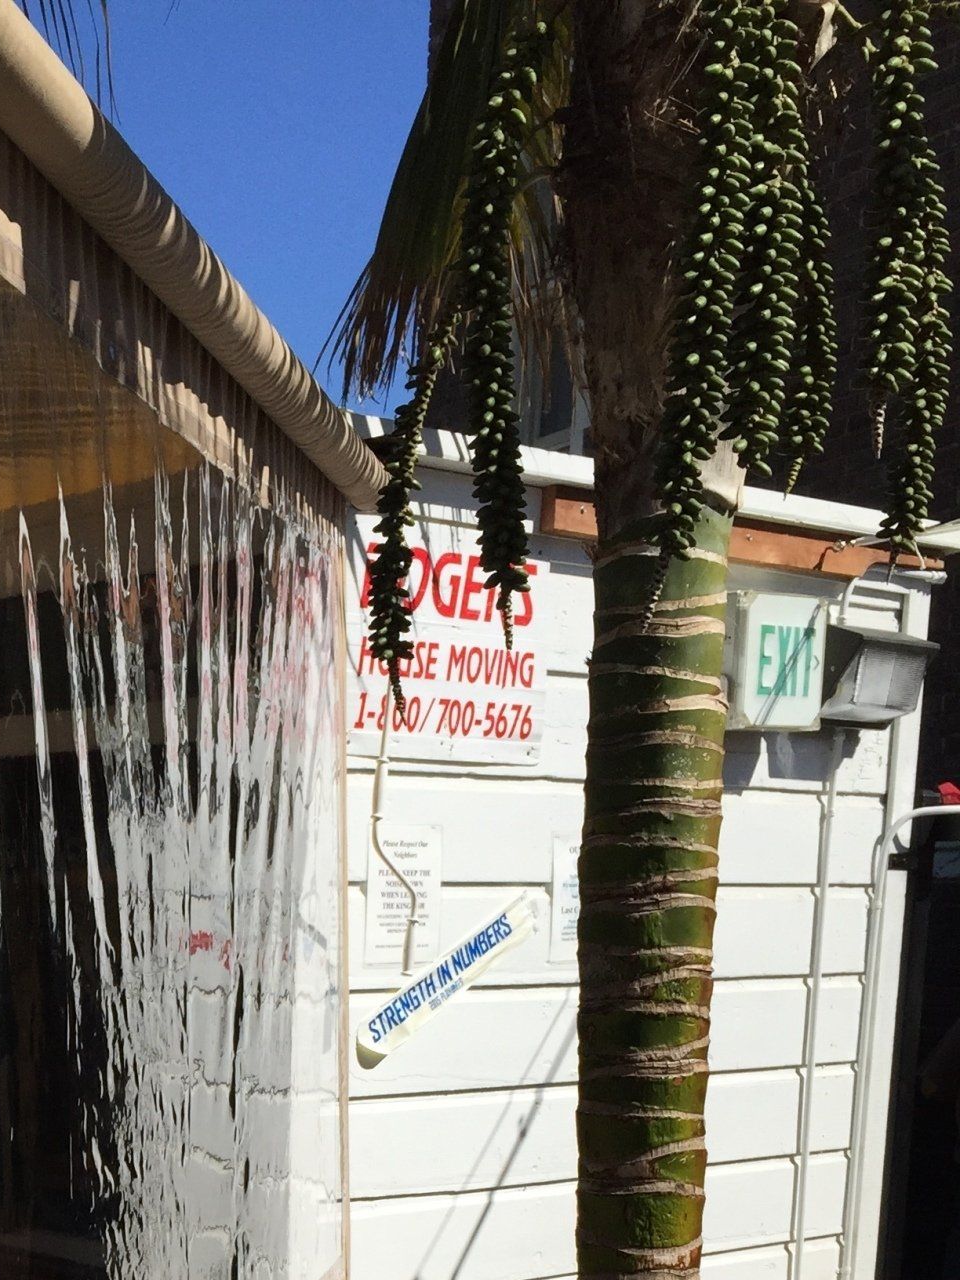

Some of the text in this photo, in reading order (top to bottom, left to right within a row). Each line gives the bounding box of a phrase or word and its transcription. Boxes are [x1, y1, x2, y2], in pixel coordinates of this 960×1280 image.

[446, 644, 535, 689] MOVING
[757, 624, 816, 697] EXIT
[368, 912, 512, 1043] STRENGTH IN NUMBERS
